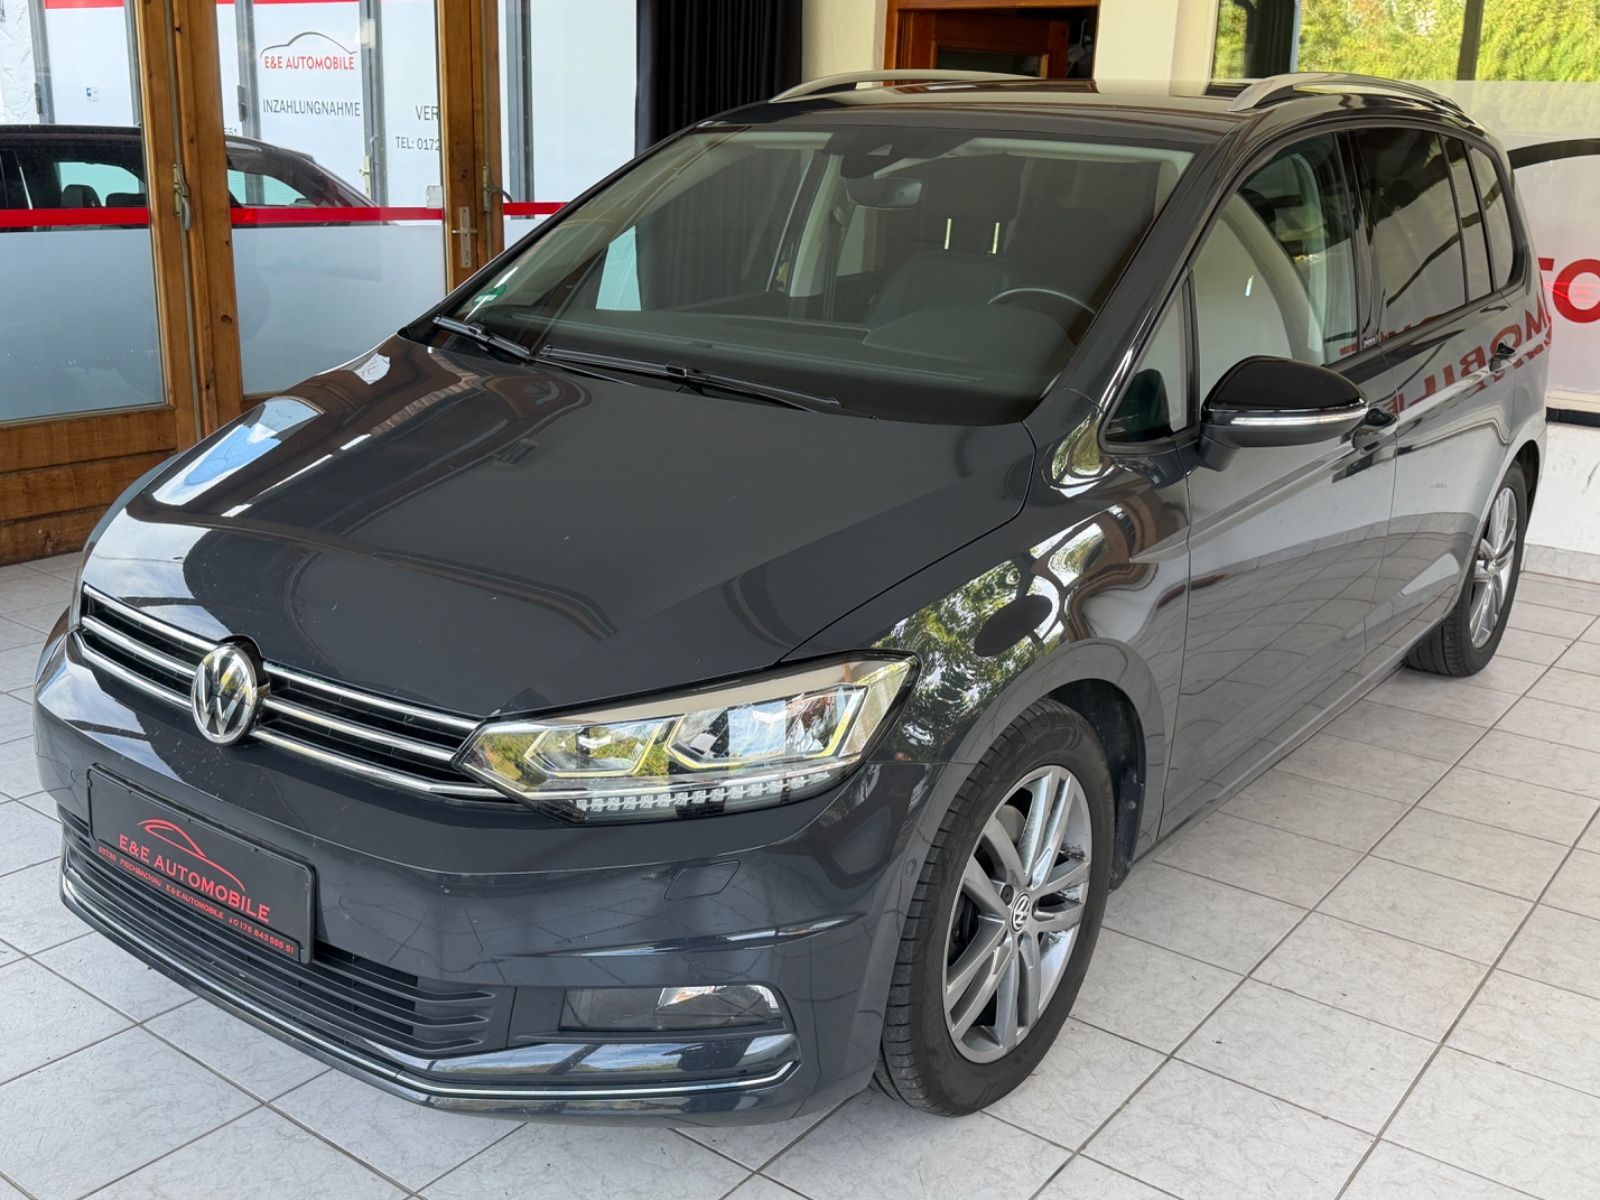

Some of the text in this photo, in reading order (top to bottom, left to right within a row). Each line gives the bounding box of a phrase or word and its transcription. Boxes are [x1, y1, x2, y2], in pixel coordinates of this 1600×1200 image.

[264, 56, 355, 70] E&E AUTOMOBILE
[262, 100, 361, 117] INZAHLUNGNAHME
[395, 136, 415, 149] TEL:
[119, 834, 271, 924] E&E AUTOMOBILE
